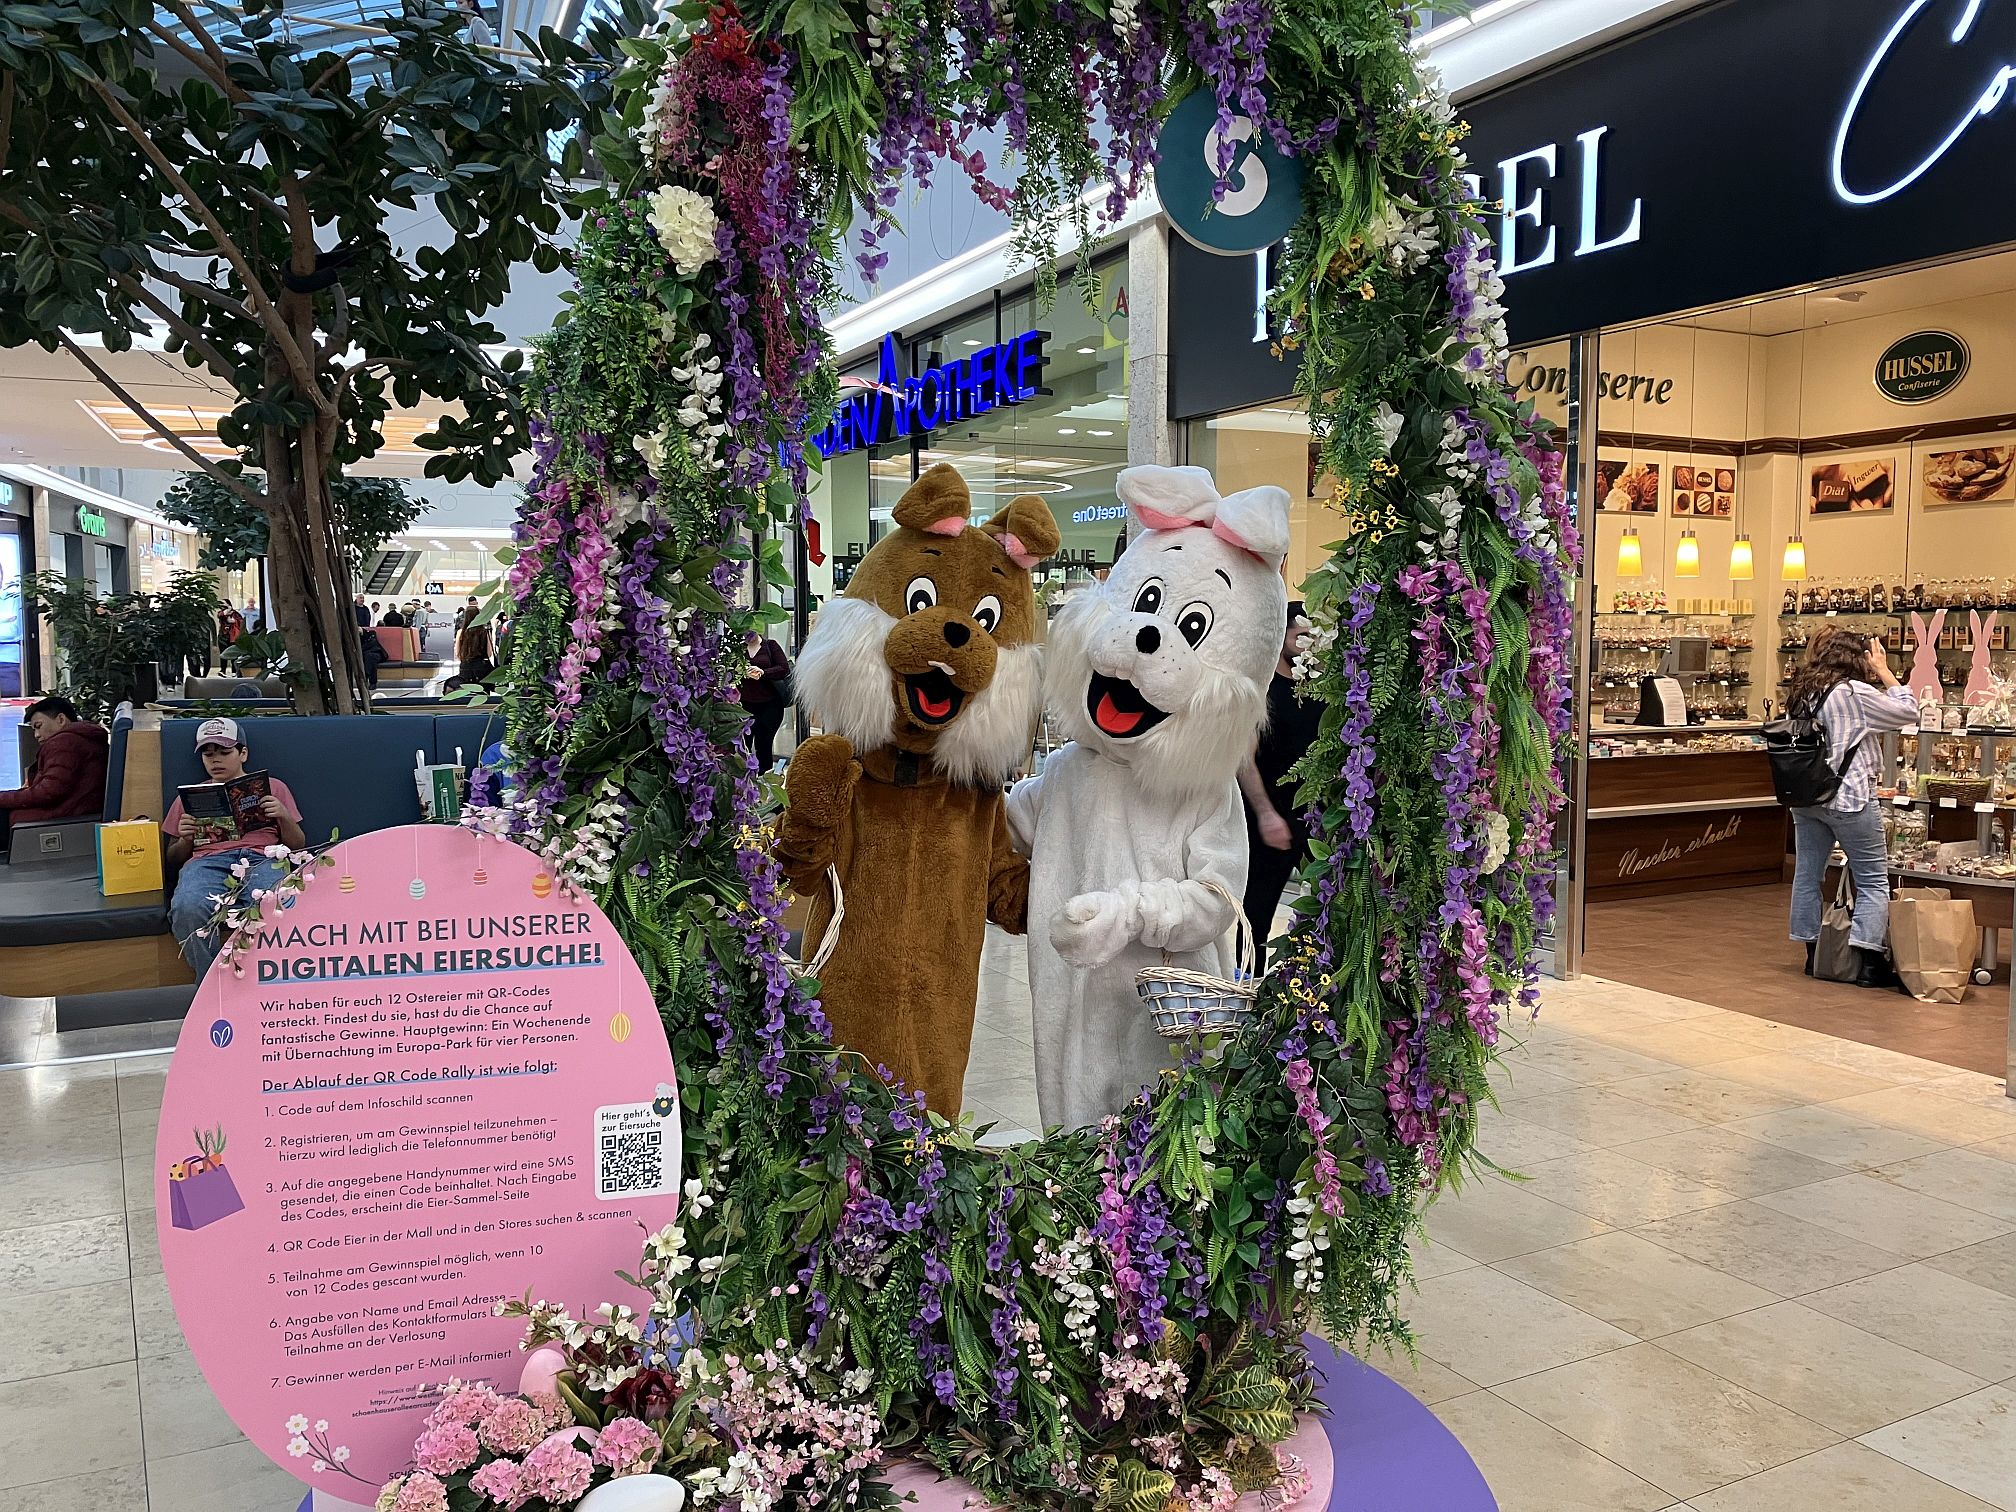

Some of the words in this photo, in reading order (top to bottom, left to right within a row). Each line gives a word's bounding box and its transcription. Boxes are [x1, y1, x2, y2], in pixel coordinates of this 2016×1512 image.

[1504, 351, 1674, 406] Conserie
[1884, 350, 1957, 381] HUSSEL
[869, 330, 1038, 445] APOTHEKE
[1898, 379, 1941, 391] Confiserie
[1852, 463, 1879, 485] Ingwer
[1823, 485, 1845, 496] Diät
[1684, 814, 1741, 854] erlaubt
[257, 924, 347, 949] MACH
[359, 921, 408, 944] MIT
[418, 919, 456, 941] BEI
[468, 913, 591, 938] UNSERER
[258, 952, 423, 984] DIGITALEN
[434, 943, 601, 966] EIERSUCHE!
[260, 1001, 284, 1012] Wir
[289, 998, 328, 1010] haben
[333, 996, 349, 1007] für
[354, 994, 382, 1006] euch
[388, 994, 401, 1004] 12
[406, 991, 462, 1003] Ostereier
[467, 990, 483, 999] mit
[488, 985, 550, 998] QR-Codes
[261, 1015, 319, 1028] versteckt.
[325, 1012, 367, 1024] Findest
[372, 1011, 386, 1021] du
[391, 1011, 410, 1021] sie,
[415, 1008, 439, 1019] hast
[443, 1006, 457, 1017] du
[462, 1005, 480, 1016] die
[485, 1003, 529, 1014] Chance
[533, 1000, 552, 1011] auf
[262, 1030, 335, 1045] fantastische
[340, 1029, 398, 1040] Gewinne.
[404, 1022, 487, 1038] Hauptgewinn:
[492, 1020, 508, 1030] Ein
[513, 1014, 590, 1028] Wochenende
[263, 1051, 280, 1062] mit
[286, 1046, 374, 1060] Übernachtung
[379, 1044, 392, 1054] im
[397, 1037, 472, 1054] Europa-Park
[477, 1036, 493, 1047] für
[496, 1036, 518, 1045] vier
[522, 1033, 578, 1044] Personen.
[263, 1080, 288, 1092] Der
[293, 1074, 341, 1089] Ablauf
[346, 1073, 368, 1085] der
[374, 1071, 396, 1083] QR
[401, 1068, 436, 1081] Code
[443, 1065, 475, 1080] Rally
[480, 1065, 493, 1076] ist
[497, 1063, 519, 1075] wie
[525, 1060, 557, 1074] folgt:
[265, 1107, 274, 1117] 1.
[279, 1104, 311, 1115] Code
[317, 1101, 335, 1112] auf
[339, 1100, 363, 1111] dem
[369, 1095, 422, 1109] Infoschild
[427, 1095, 472, 1104] scannen
[265, 1137, 275, 1147] 2.
[280, 1132, 352, 1148] Registrieren,
[356, 1129, 373, 1140] um
[378, 1128, 395, 1138] am
[399, 1120, 469, 1136] Gewinnspiel
[474, 1116, 546, 1132] teilzunehmen
[620, 1119, 660, 1130] Eiersuche
[280, 1151, 315, 1161] hierzu
[319, 1145, 344, 1157] wird
[349, 1139, 397, 1156] lediglich
[402, 1140, 418, 1150] die
[423, 1136, 507, 1148] Telefonnummer
[512, 1130, 556, 1141] benötigt
[266, 1183, 277, 1193] 3.
[281, 1179, 302, 1191] Auf
[306, 1178, 323, 1189] die
[328, 1172, 402, 1188] angegebene
[407, 1165, 490, 1182] Handynummer
[494, 1160, 517, 1172] wird
[521, 1161, 543, 1169] eine
[548, 1156, 573, 1167] SMS
[280, 1193, 338, 1211] gesendet,
[343, 1190, 360, 1200] die
[364, 1189, 395, 1198] einen
[400, 1183, 430, 1195] Code
[435, 1178, 492, 1192] beinhaltet.
[498, 1174, 527, 1186] Nach
[532, 1170, 576, 1184] Eingabe
[281, 1211, 301, 1221] des
[306, 1206, 347, 1219] Codes,
[352, 1202, 402, 1214] erscheint
[406, 1199, 423, 1209] die
[425, 1187, 529, 1207] Eier-Sammel-Seite
[267, 1243, 278, 1252] 4.
[284, 1240, 302, 1251] QR
[307, 1237, 339, 1249] Code
[345, 1235, 366, 1245] Eier
[370, 1234, 379, 1242] in
[384, 1230, 402, 1241] der
[407, 1226, 432, 1239] Mall
[437, 1224, 456, 1235] und
[461, 1225, 470, 1233] in
[474, 1221, 494, 1232] den
[499, 1220, 532, 1229] Stores
[536, 1214, 572, 1226] suchen
[577, 1212, 584, 1221] &
[588, 1210, 631, 1220] scannen
[268, 1274, 279, 1284] 5.
[283, 1268, 343, 1283] Teilnahme
[347, 1267, 364, 1275] am
[369, 1255, 440, 1272] Gewinnspiel
[444, 1250, 490, 1265] möglich,
[495, 1251, 524, 1259] wenn
[531, 1245, 543, 1255] 10
[286, 1289, 307, 1297] von
[314, 1284, 325, 1294] 12
[331, 1280, 368, 1292] Codes
[373, 1275, 417, 1290] gescant
[421, 1269, 466, 1282] wurden.
[270, 1318, 281, 1328] 6.
[285, 1313, 334, 1329] Angabe
[337, 1312, 358, 1320] von
[363, 1307, 398, 1317] Name
[403, 1300, 423, 1312] und
[429, 1296, 458, 1309] Email
[462, 1294, 505, 1306] Adresse
[285, 1332, 307, 1341] Das
[311, 1324, 364, 1338] Ausfüllen
[369, 1321, 388, 1331] des
[392, 1309, 487, 1329] Kontaktformulars
[284, 1342, 343, 1356] Teilnahme
[367, 1336, 385, 1346] der
[389, 1331, 445, 1343] Verlosung
[272, 1378, 279, 1388] 7.
[286, 1373, 344, 1386] Gewinner
[348, 1365, 390, 1377] werden
[396, 1364, 414, 1375] per
[418, 1358, 456, 1370] E-Mail
[460, 1350, 511, 1364] informiert
